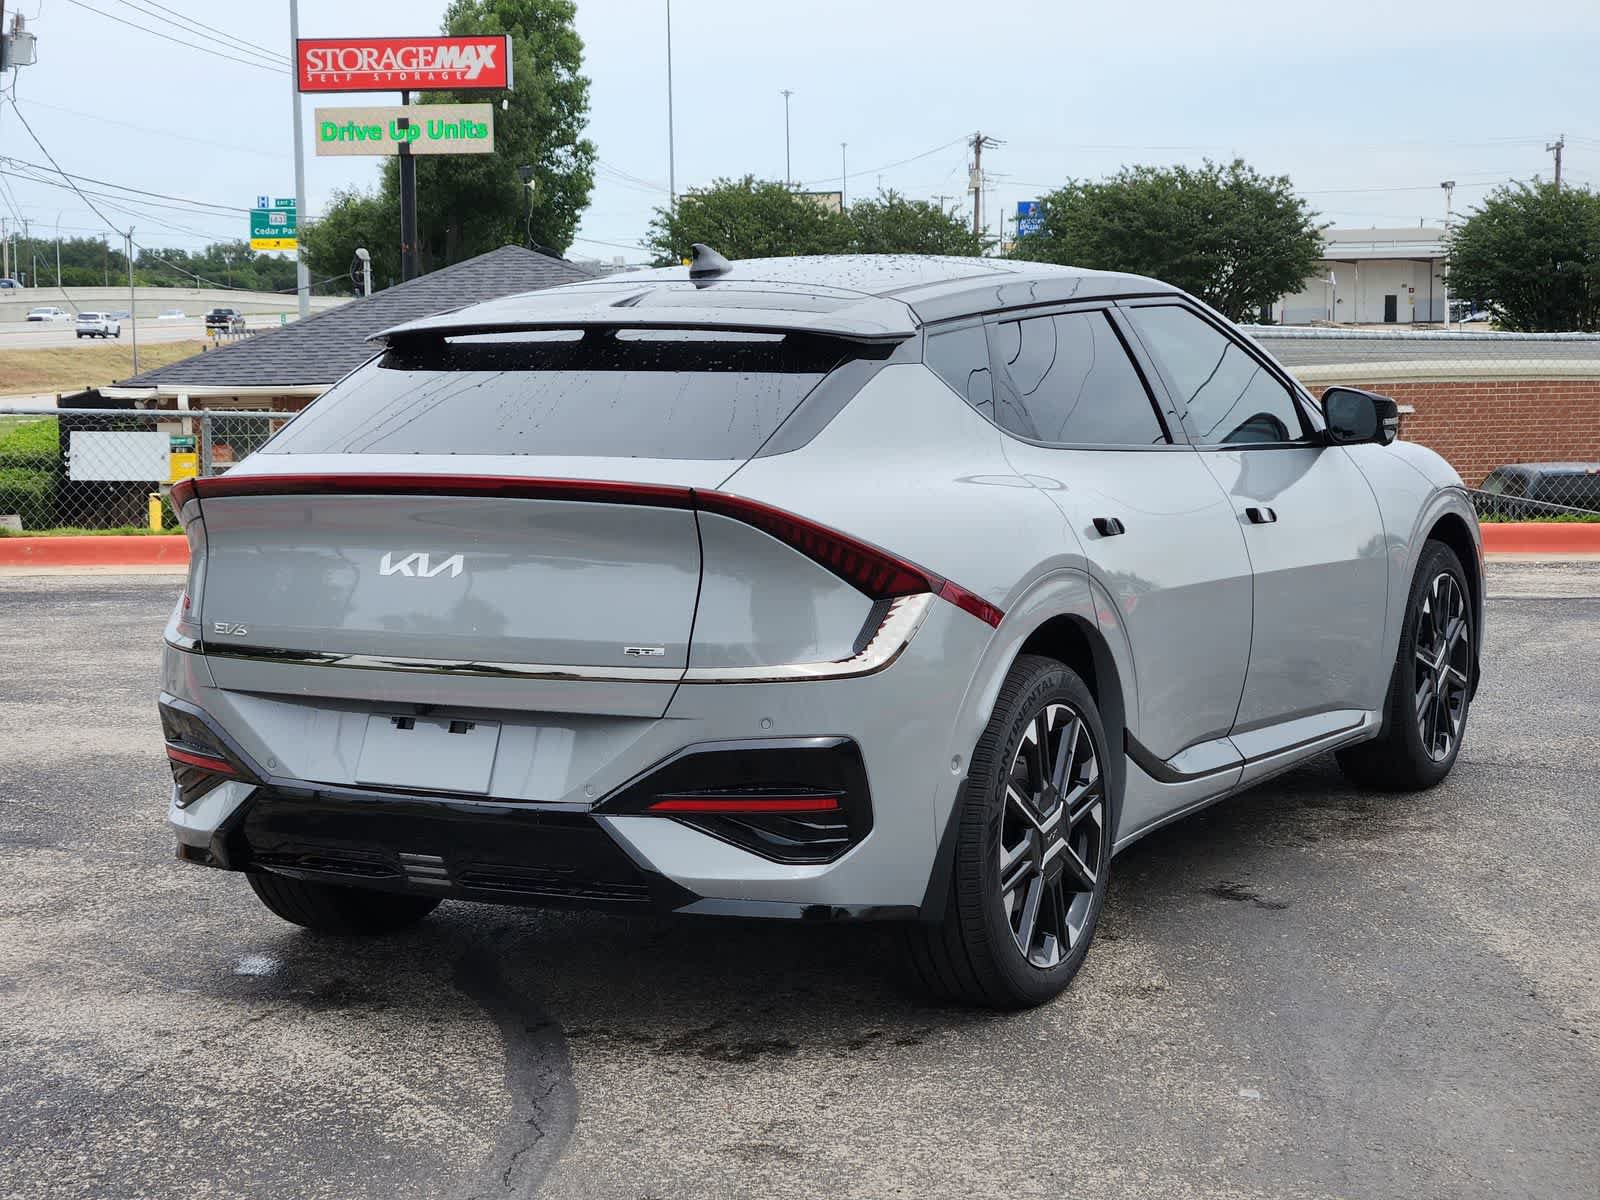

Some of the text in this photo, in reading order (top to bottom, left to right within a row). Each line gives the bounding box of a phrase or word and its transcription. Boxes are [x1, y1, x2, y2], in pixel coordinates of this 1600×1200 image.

[306, 71, 461, 82] SELF STORAGE
[321, 117, 488, 144] Drive Up Units
[255, 226, 297, 235] Cedar Par
[379, 551, 464, 578] KIA
[214, 622, 248, 636] EV6
